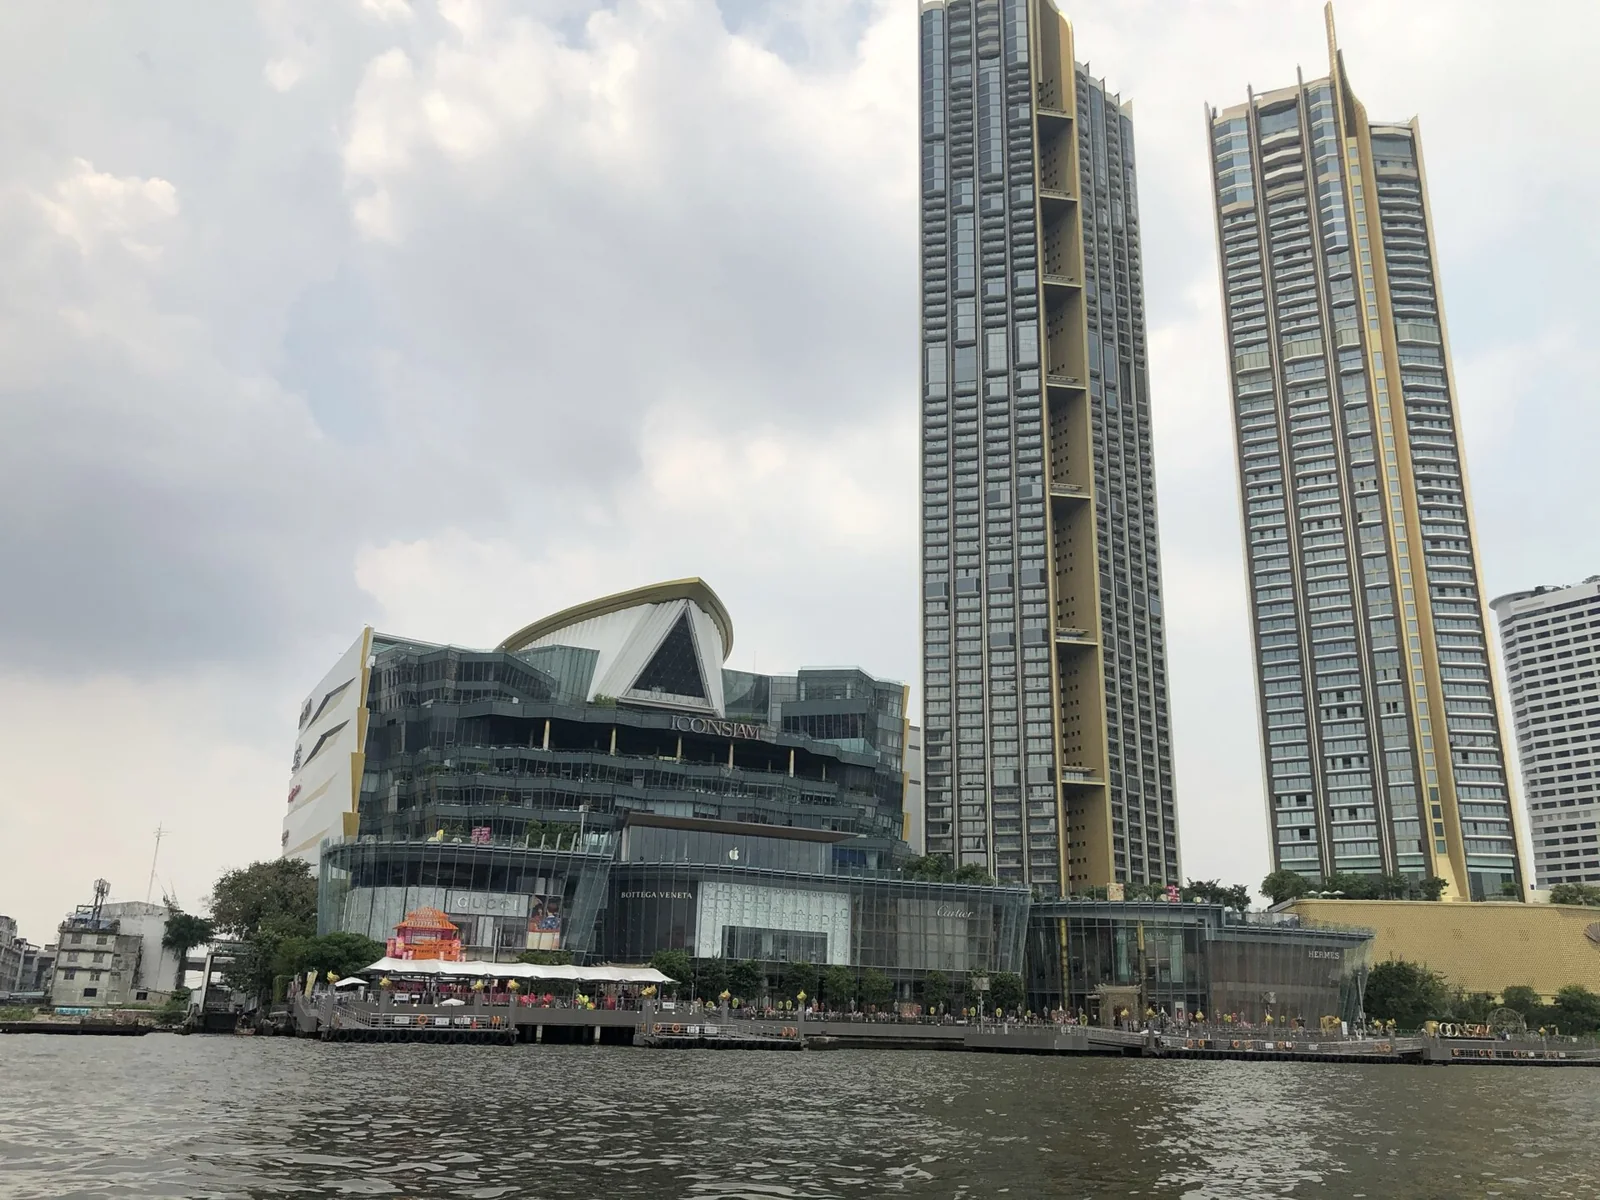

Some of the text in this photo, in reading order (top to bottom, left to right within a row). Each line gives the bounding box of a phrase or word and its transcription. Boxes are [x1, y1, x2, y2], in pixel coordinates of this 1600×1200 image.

[670, 715, 761, 741] ICONSIAM
[621, 891, 693, 900] BOTTEGA VENETA
[456, 897, 518, 911] GUCCI
[936, 904, 974, 918] Cartier
